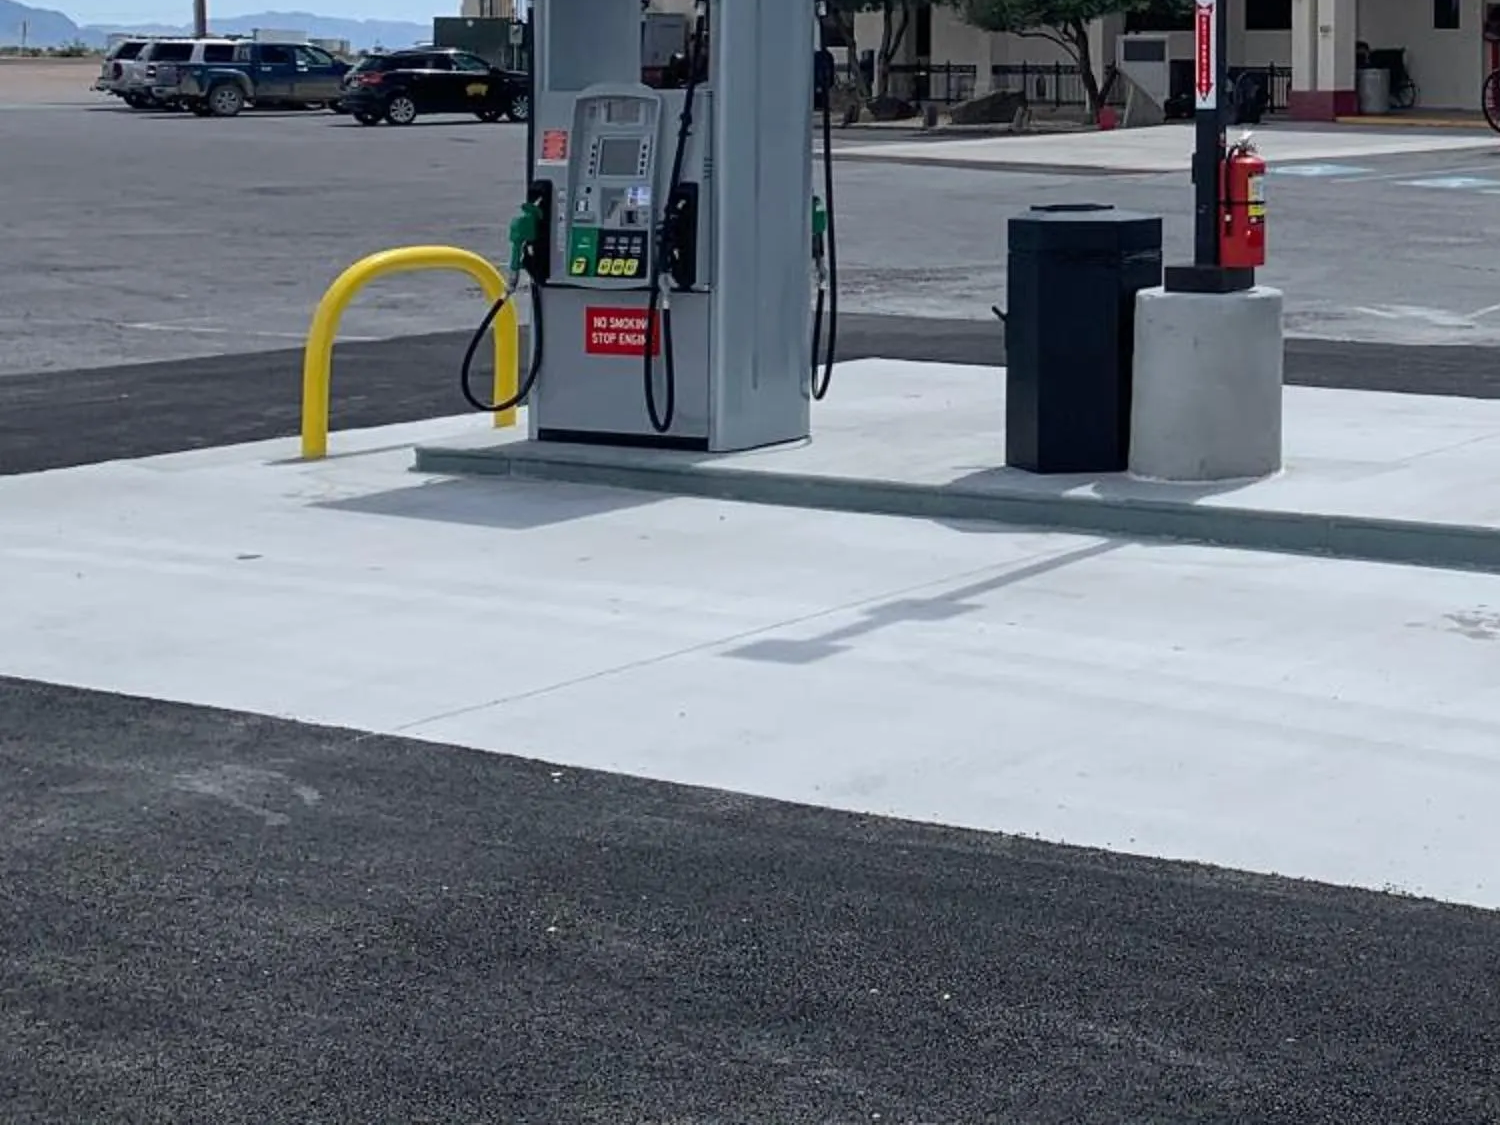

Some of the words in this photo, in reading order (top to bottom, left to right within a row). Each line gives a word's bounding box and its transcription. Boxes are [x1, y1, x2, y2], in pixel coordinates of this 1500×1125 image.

[593, 316, 607, 329] NO
[609, 316, 650, 330] SMOKIN
[592, 332, 616, 344] STOP
